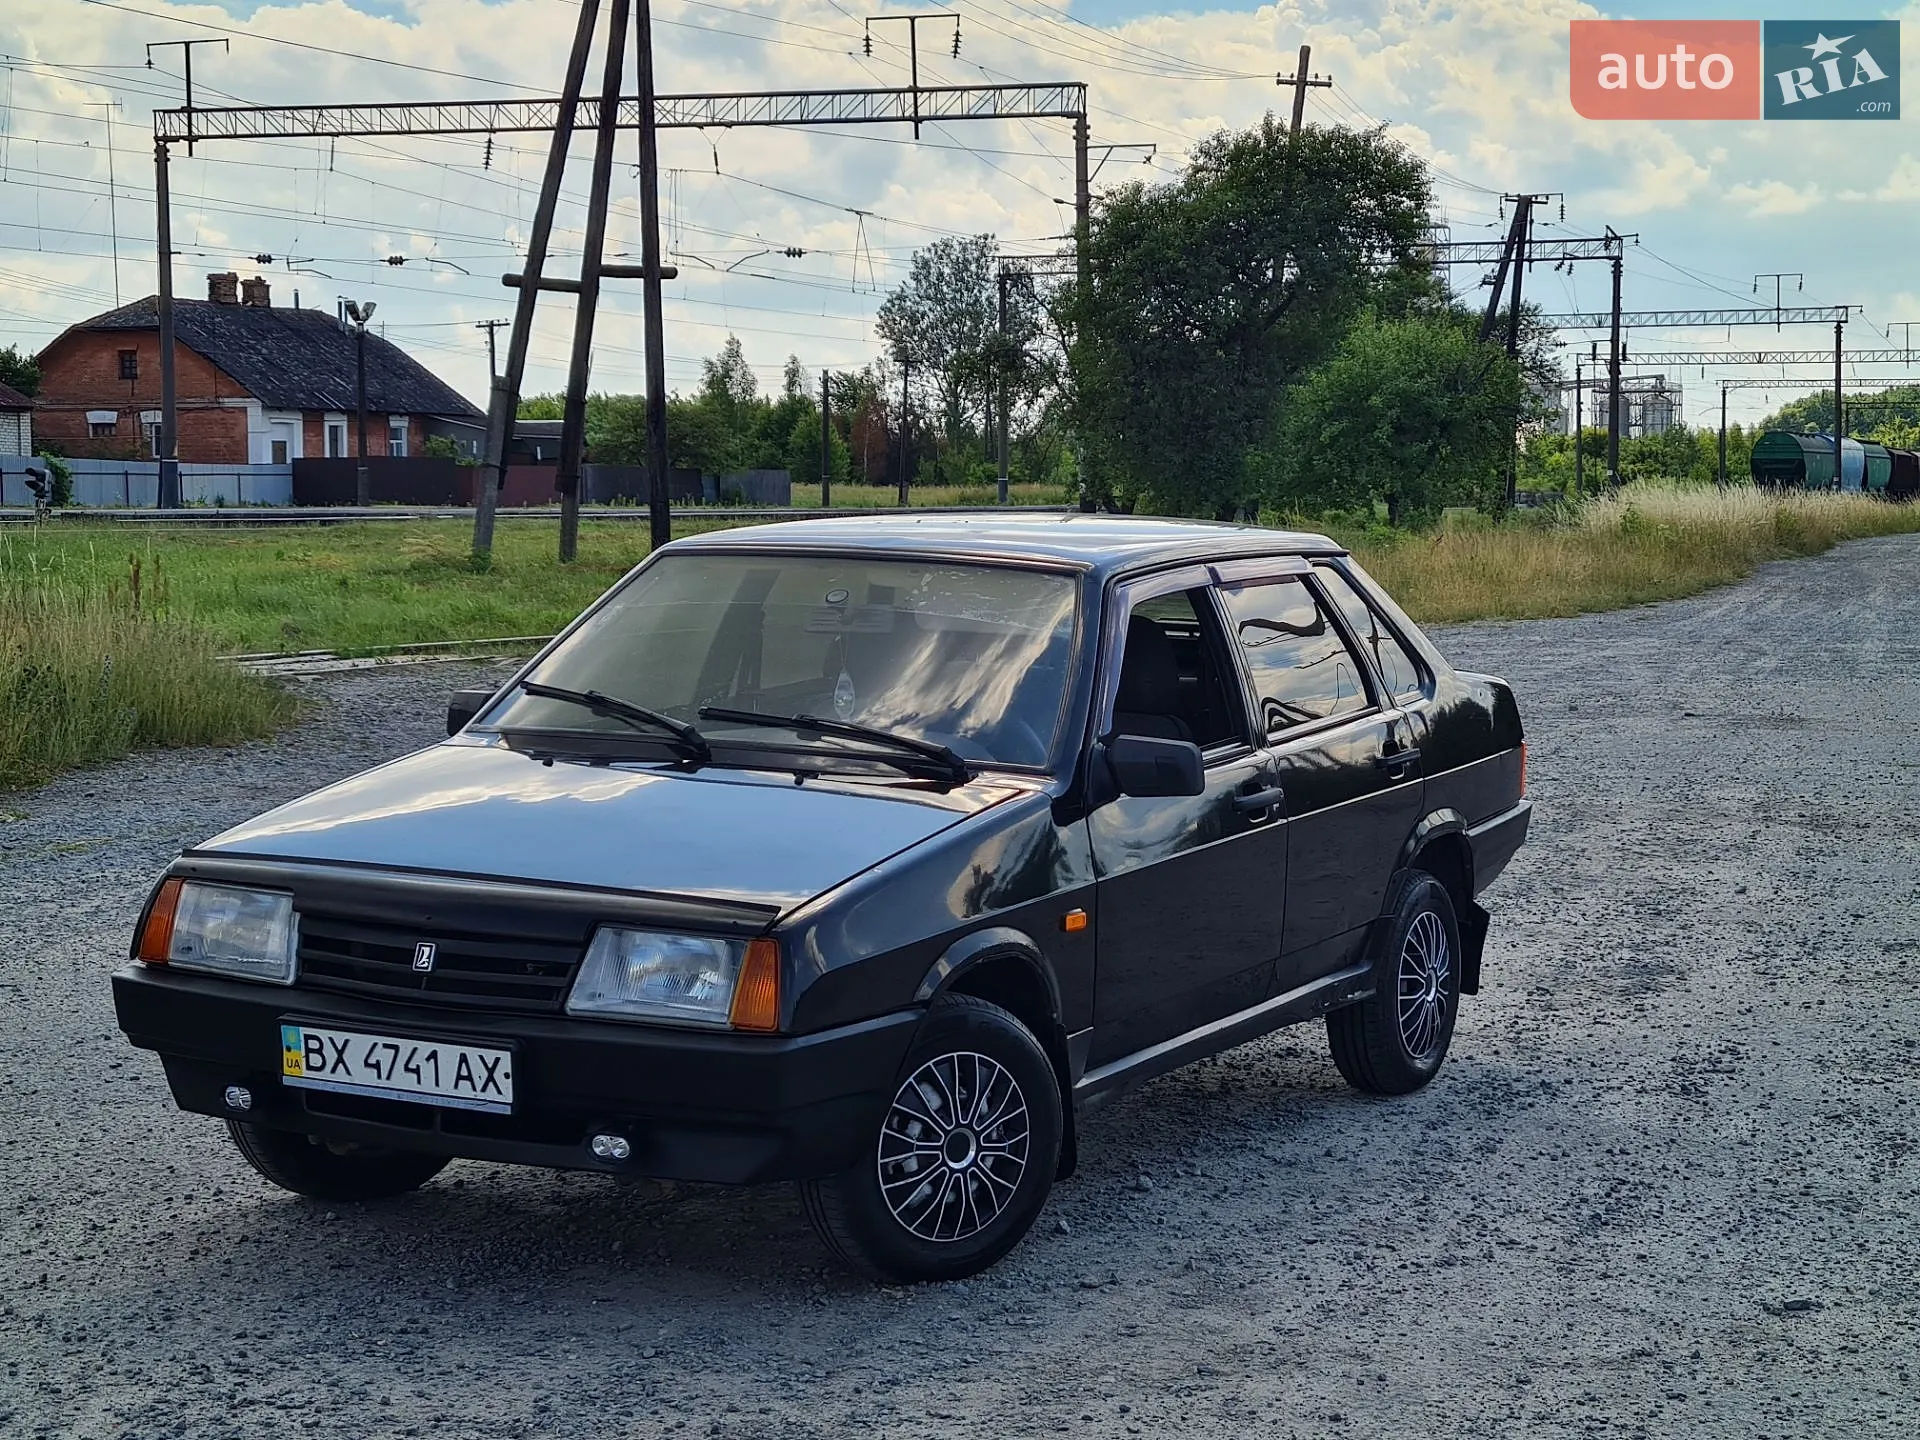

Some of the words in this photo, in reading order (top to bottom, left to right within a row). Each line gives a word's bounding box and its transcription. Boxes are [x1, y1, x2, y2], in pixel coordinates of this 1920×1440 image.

[286, 1058, 301, 1070] UA
[303, 1033, 350, 1076] BX
[363, 1042, 440, 1087] 4741
[454, 1052, 503, 1095] AX
